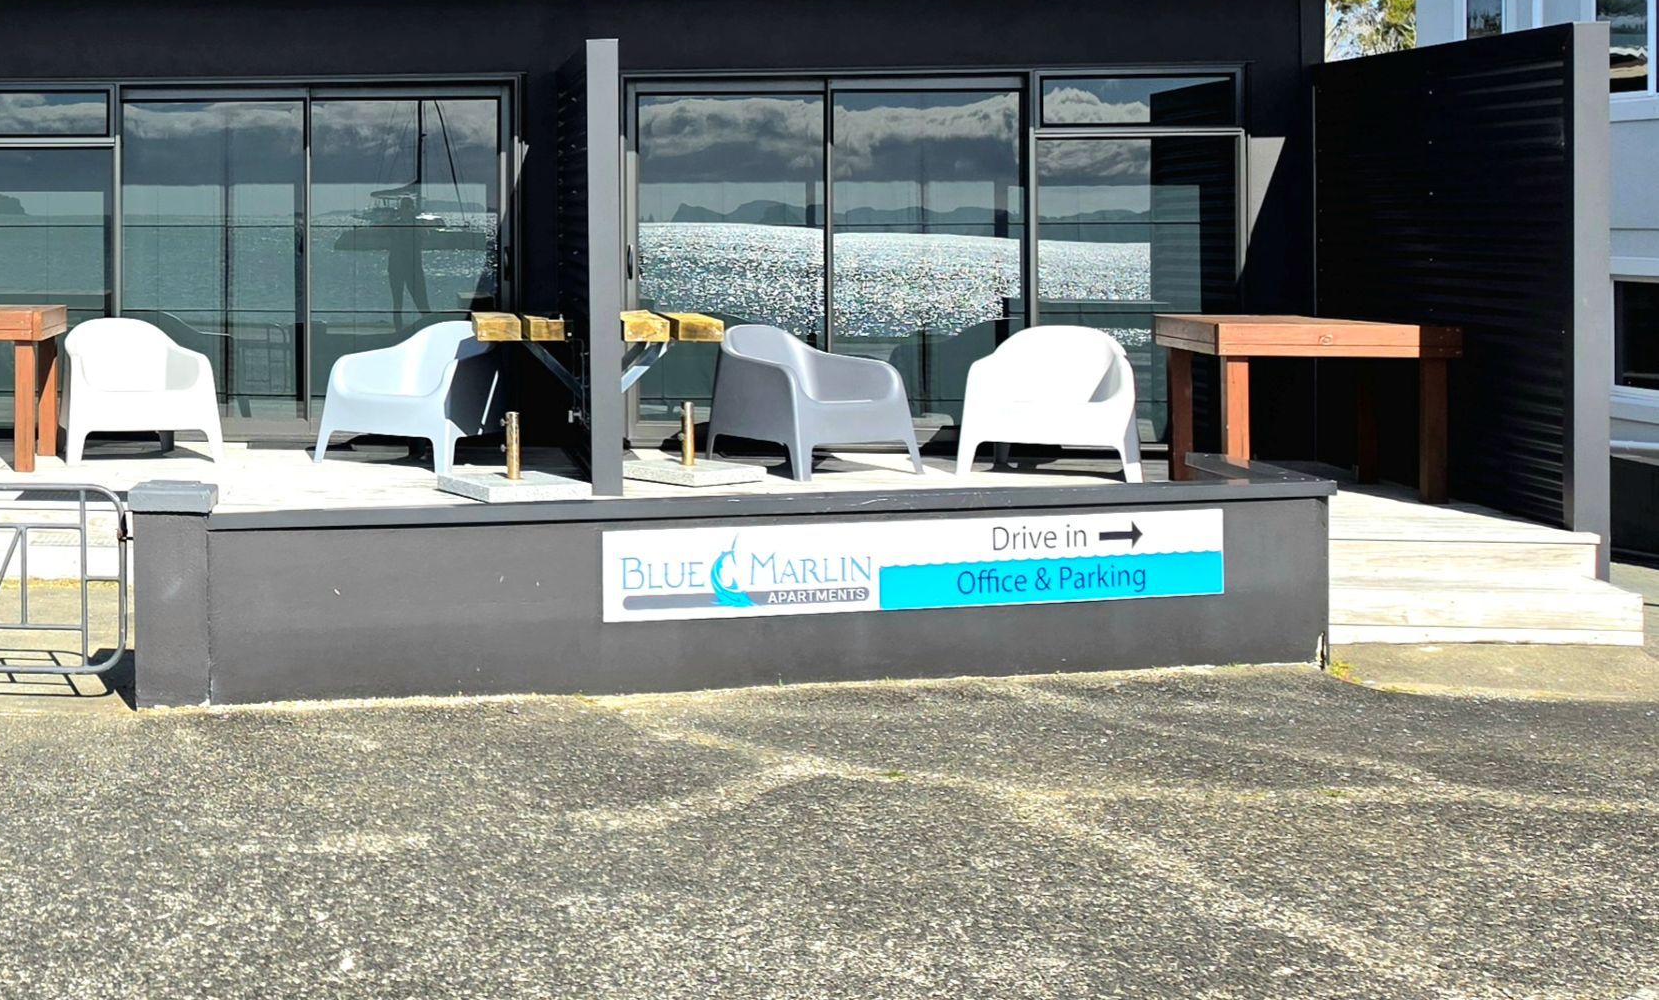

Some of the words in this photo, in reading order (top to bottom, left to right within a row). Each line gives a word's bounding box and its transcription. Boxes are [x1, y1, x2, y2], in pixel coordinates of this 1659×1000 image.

[992, 525, 1056, 552] Drive
[1065, 524, 1087, 548] in
[621, 557, 704, 590] BLUE
[751, 552, 871, 586] MARLIN
[957, 566, 1027, 595] Office
[1034, 567, 1051, 591] &
[1061, 565, 1146, 595] Parking
[768, 588, 866, 603] APARTMENTS
